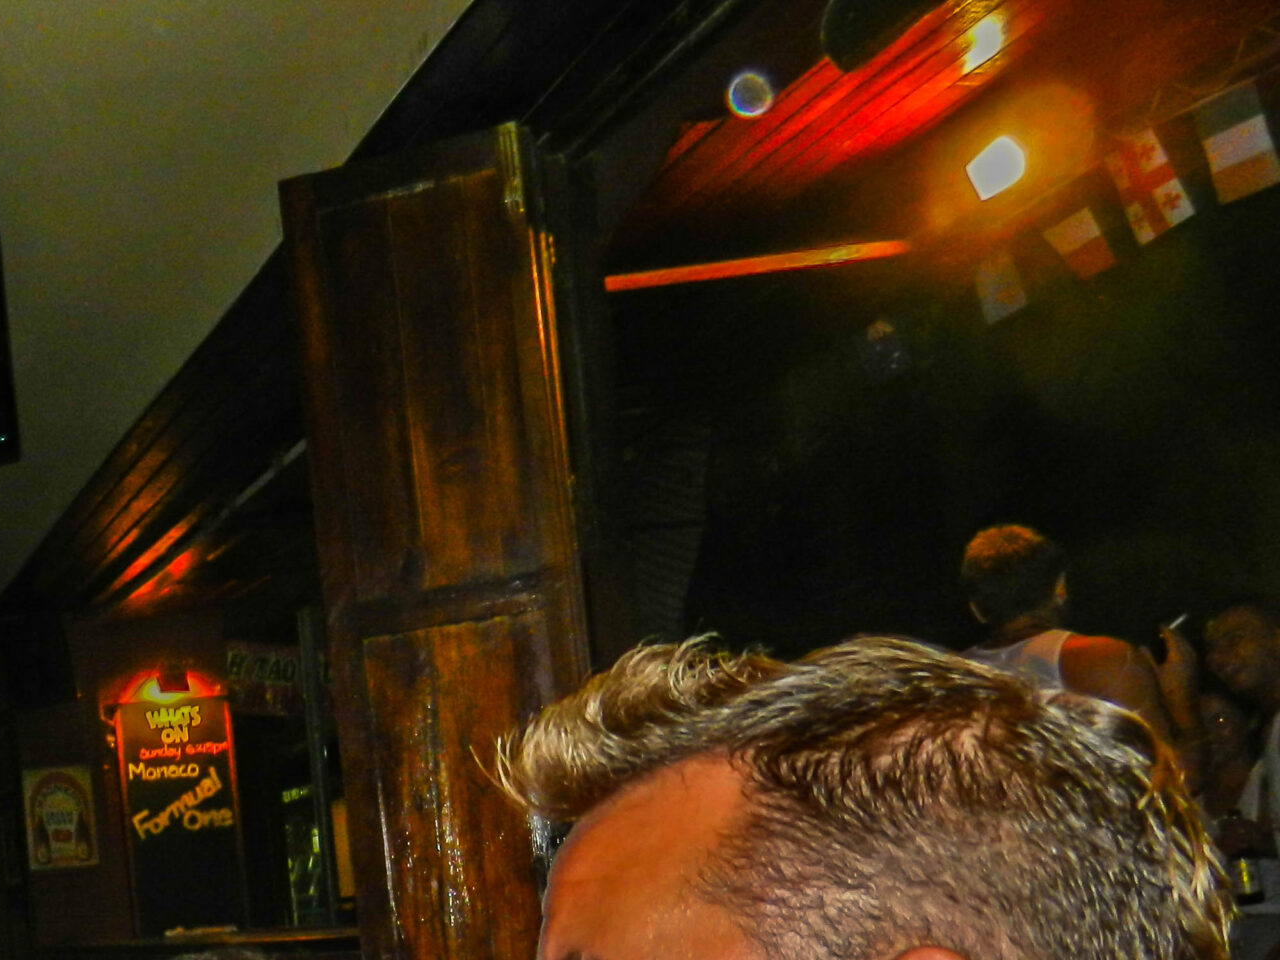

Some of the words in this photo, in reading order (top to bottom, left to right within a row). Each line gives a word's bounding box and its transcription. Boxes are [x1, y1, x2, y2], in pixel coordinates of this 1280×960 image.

[161, 724, 189, 744] ON
[128, 762, 200, 780] Monaco
[183, 808, 233, 830] One
